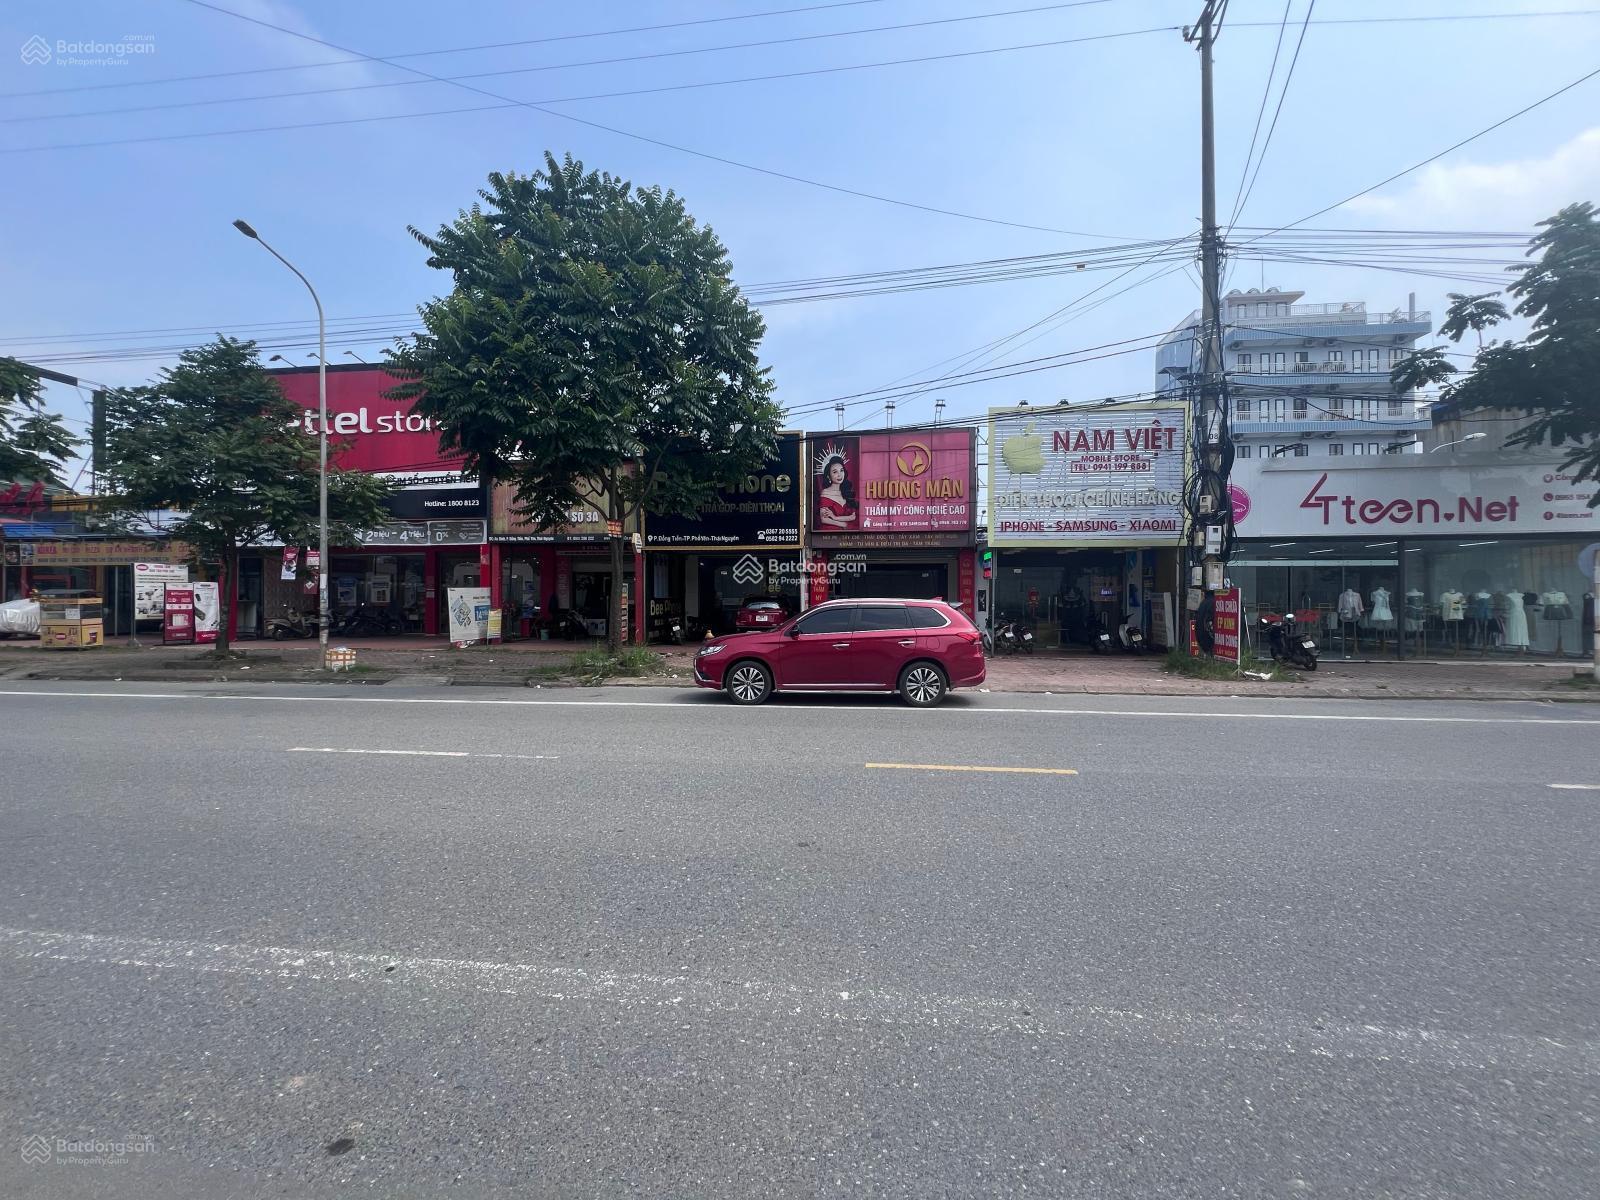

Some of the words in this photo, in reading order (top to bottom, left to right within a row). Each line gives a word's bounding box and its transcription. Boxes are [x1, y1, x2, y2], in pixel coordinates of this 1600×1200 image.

[1053, 429, 1115, 452] NAM
[1124, 419, 1177, 457] VIỆT
[1081, 455, 1112, 463] MOBILE
[1114, 454, 1140, 462] STORE
[865, 478, 922, 500] HƯƠNG
[926, 477, 964, 501] MẬN
[424, 500, 447, 508] Hotline:
[448, 499, 463, 507] 1800
[464, 499, 480, 507] 8123
[865, 503, 888, 516] THẨM
[890, 504, 902, 516] MỸ
[903, 504, 925, 516] CÔNG
[927, 504, 949, 517] NGHỆ
[949, 505, 966, 516] CAO
[571, 508, 583, 523] SỐ
[586, 511, 599, 522] 3A
[1000, 521, 1045, 533] IPHONE
[1056, 520, 1118, 532] SAMSUNG
[1130, 519, 1176, 531] XIAOMI
[650, 600, 664, 616] Bee
